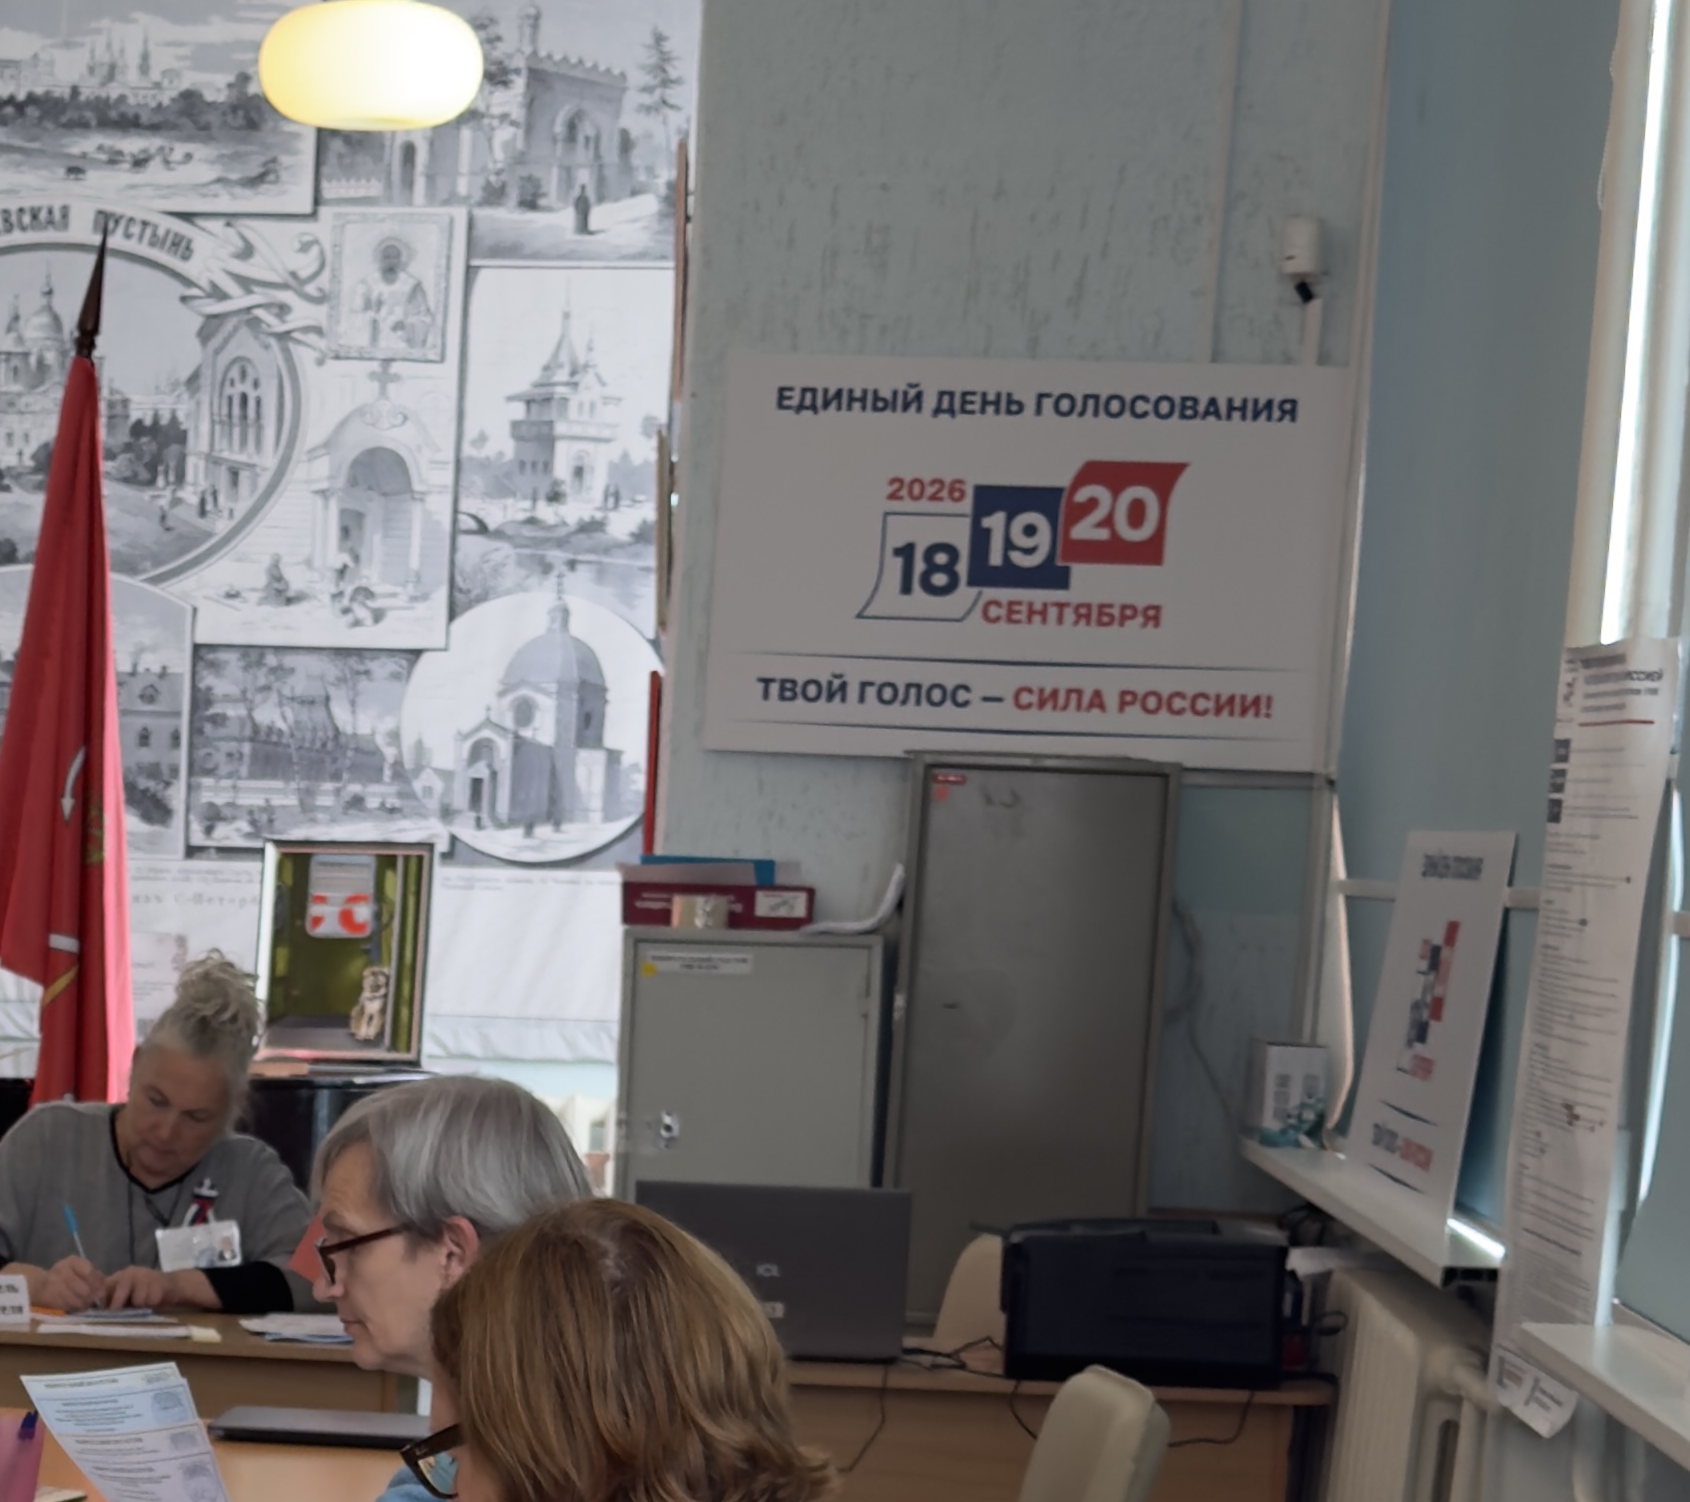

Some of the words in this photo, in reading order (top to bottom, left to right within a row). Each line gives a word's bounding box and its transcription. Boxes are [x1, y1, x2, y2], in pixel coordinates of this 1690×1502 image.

[92, 208, 195, 261] ПУСТЫНЬ
[776, 383, 923, 414] ЕДИНЫЙ
[932, 389, 1024, 418] ДЕНЬ
[1034, 393, 1299, 423] ГОЛОСОВАНИЯ
[886, 477, 966, 504] 2026
[892, 542, 960, 597] 18
[981, 511, 1051, 568] 19
[1070, 486, 1159, 542] 20
[981, 600, 1161, 629] СЕНТЯБРЯ
[757, 674, 847, 704] ТВОЙ
[857, 682, 971, 708] ГОЛОС
[1013, 685, 1106, 712] СИЛА
[1118, 690, 1273, 718] РОССИИ!
